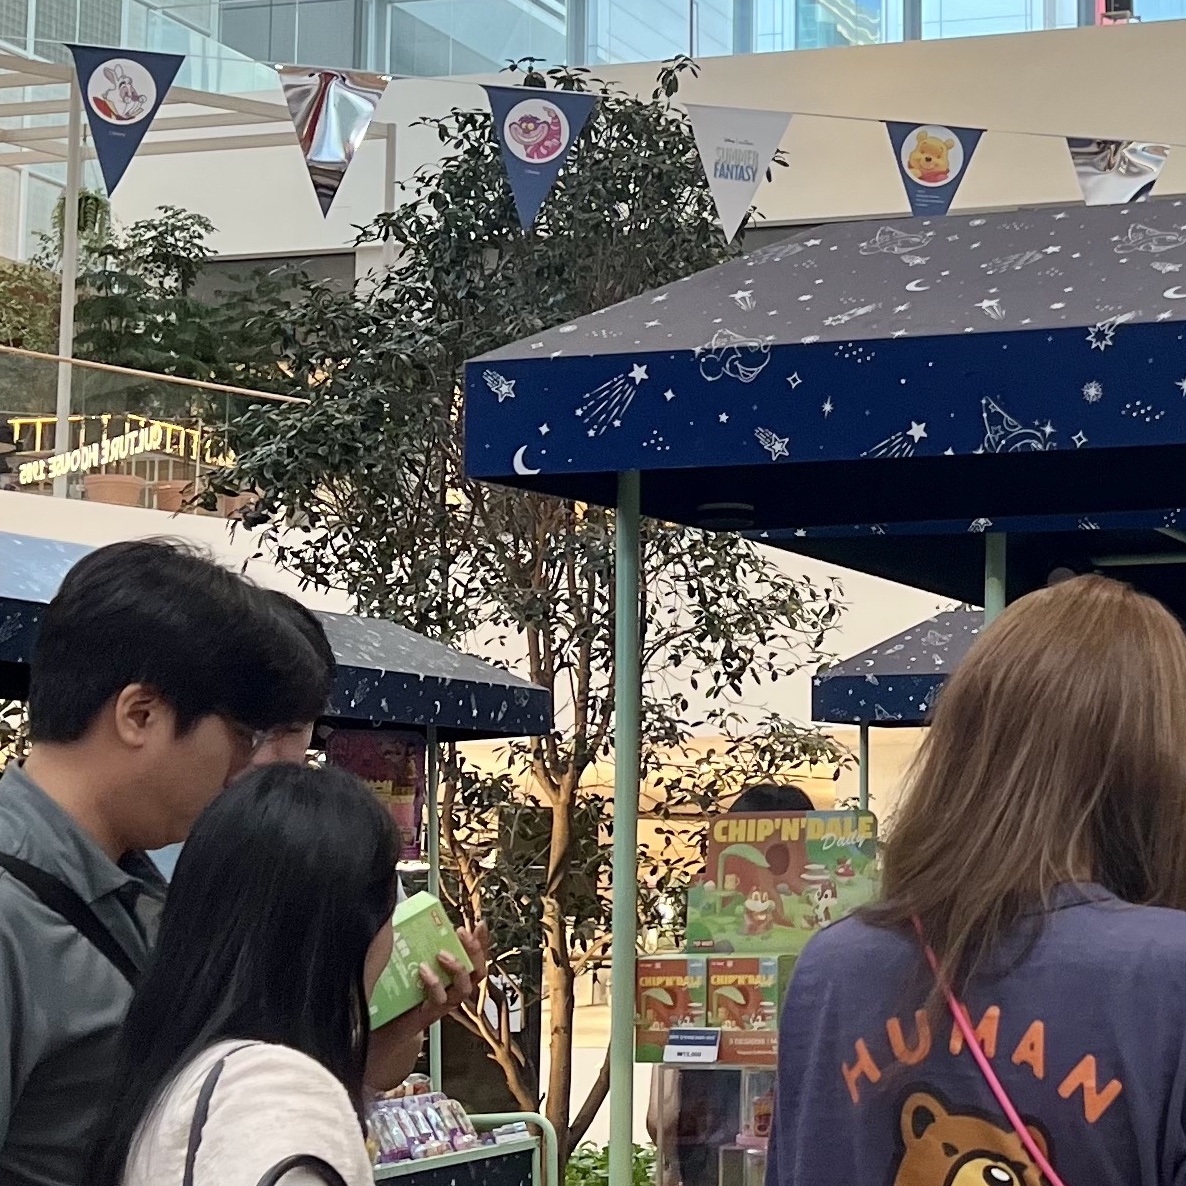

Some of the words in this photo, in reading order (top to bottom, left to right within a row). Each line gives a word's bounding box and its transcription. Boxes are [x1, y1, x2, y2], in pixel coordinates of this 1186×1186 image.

[713, 162, 758, 182] FANTASY
[820, 829, 866, 851] Daily
[842, 1004, 1122, 1123] HUMAN
